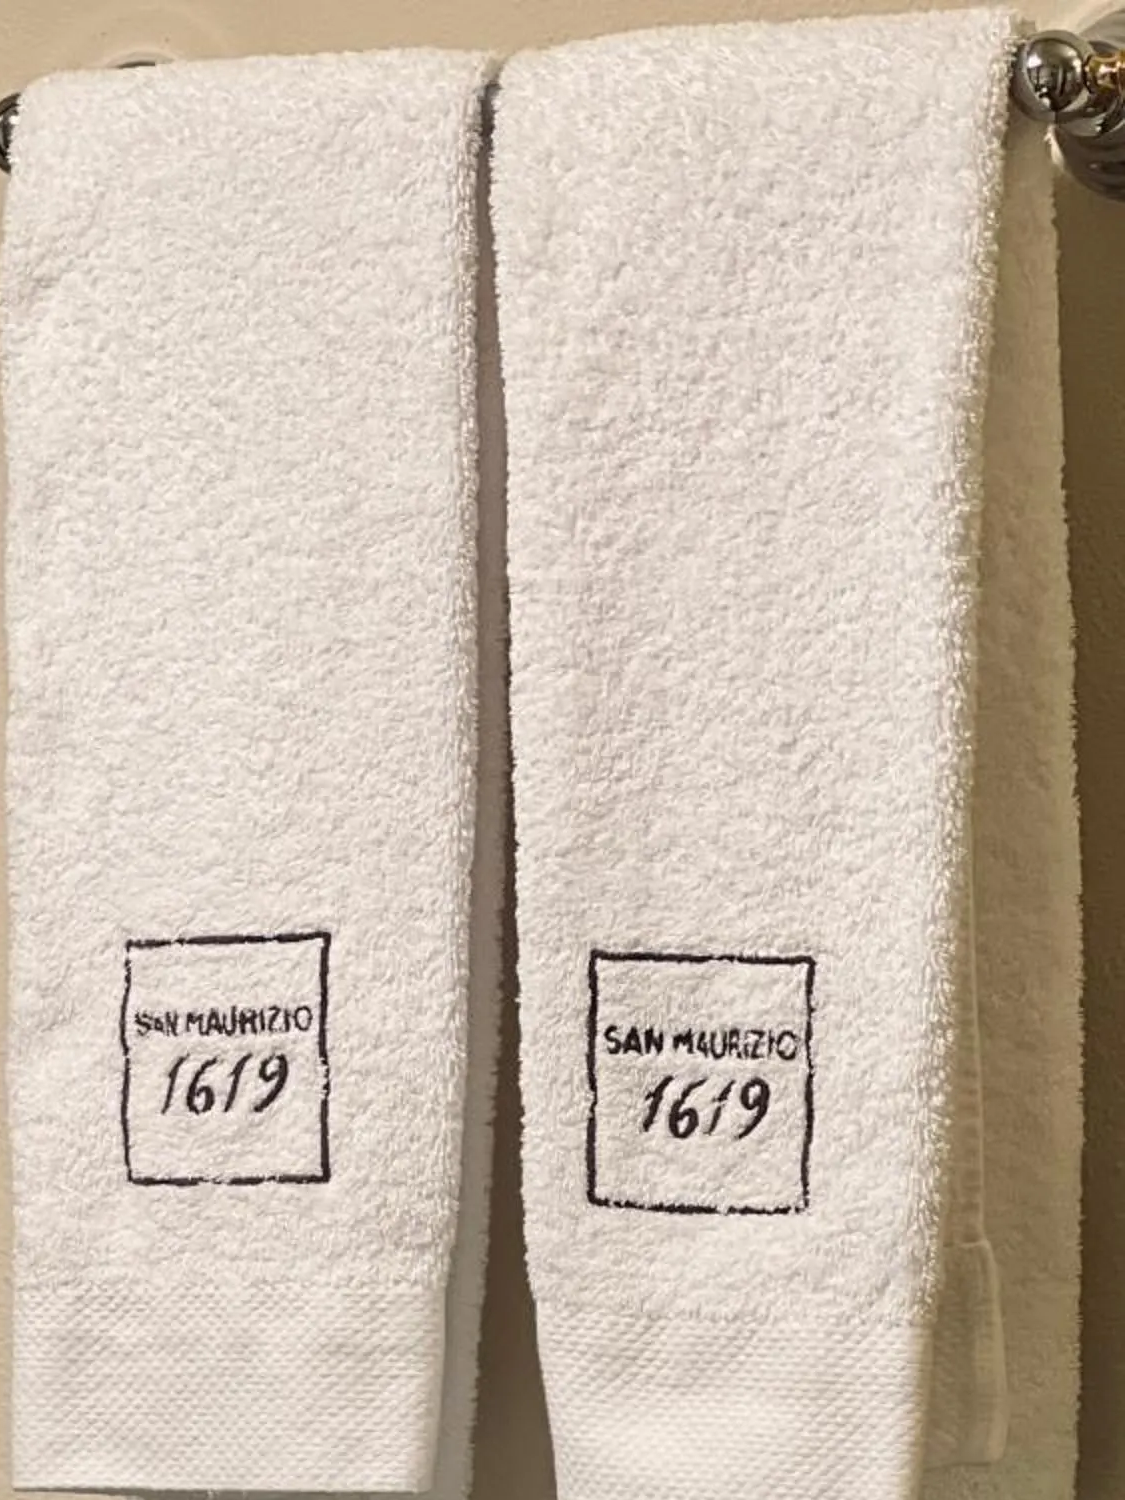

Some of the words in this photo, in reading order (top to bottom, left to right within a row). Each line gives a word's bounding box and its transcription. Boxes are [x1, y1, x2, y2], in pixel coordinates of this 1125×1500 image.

[134, 1008, 179, 1037] SAN
[185, 1005, 313, 1036] MAURIZIO
[604, 1024, 664, 1056] SAN
[672, 1027, 798, 1061] MAURIZIO
[160, 1053, 289, 1115] 1619
[641, 1075, 771, 1140] 1619
